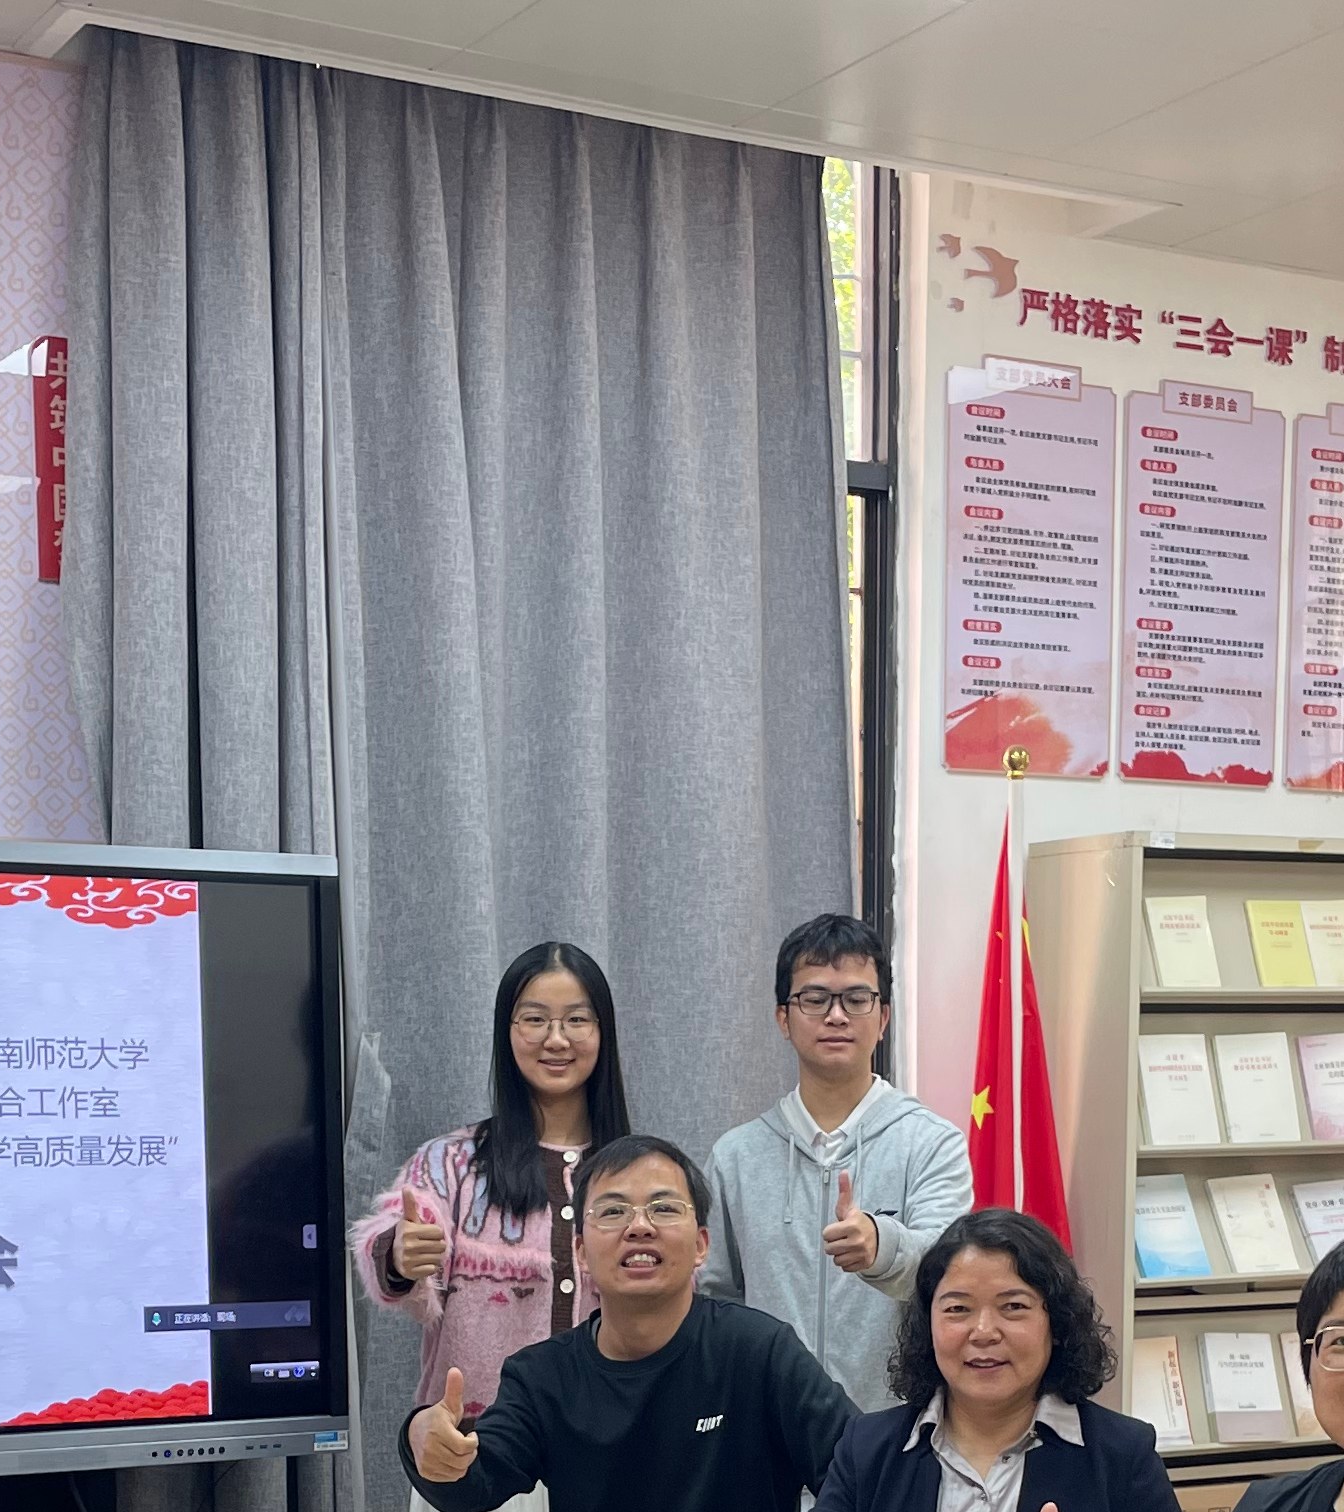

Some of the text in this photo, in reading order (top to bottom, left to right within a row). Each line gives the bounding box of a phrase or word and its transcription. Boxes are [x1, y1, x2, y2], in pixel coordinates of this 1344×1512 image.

[1178, 391, 1238, 413] 支部委员会
